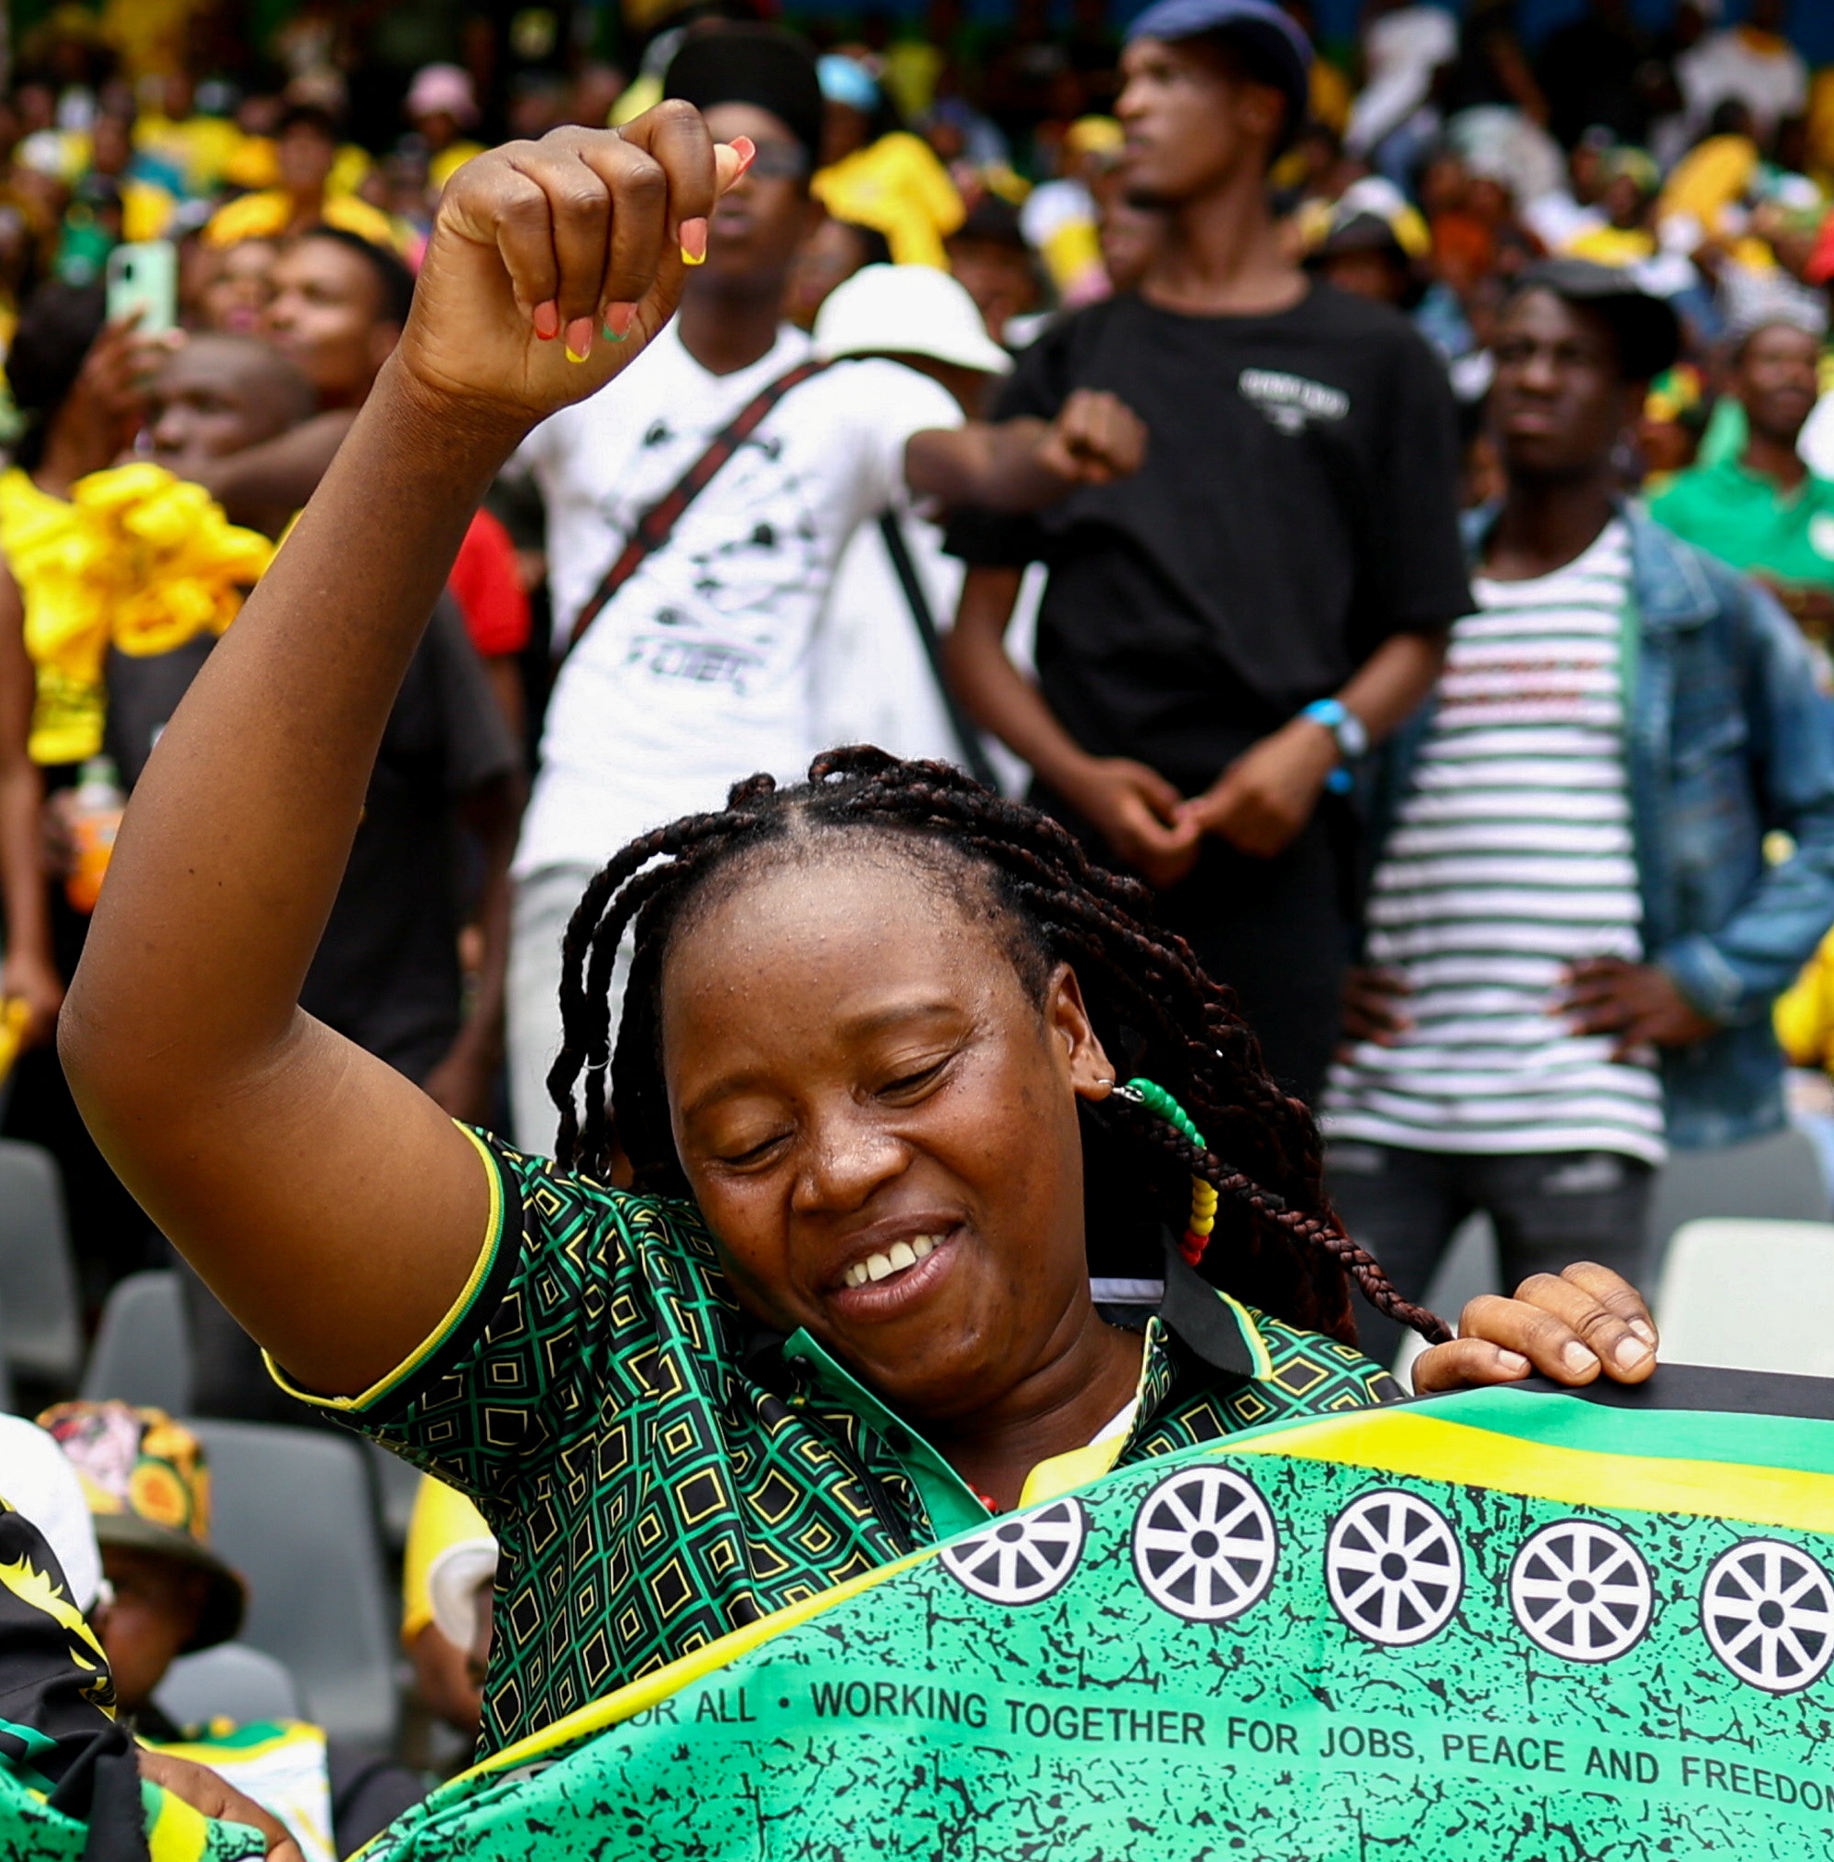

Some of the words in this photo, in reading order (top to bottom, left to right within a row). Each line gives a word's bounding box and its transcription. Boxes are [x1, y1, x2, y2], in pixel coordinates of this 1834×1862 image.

[628, 1698, 679, 1727] OR
[696, 1687, 756, 1723] ALL
[810, 1681, 987, 1730] WORKING
[1004, 1700, 1206, 1747] TOGETHER
[1227, 1716, 1300, 1756] FOR
[1319, 1726, 1425, 1764] JOBS,
[1443, 1734, 1566, 1773] PEACE
[1584, 1746, 1660, 1785] AND
